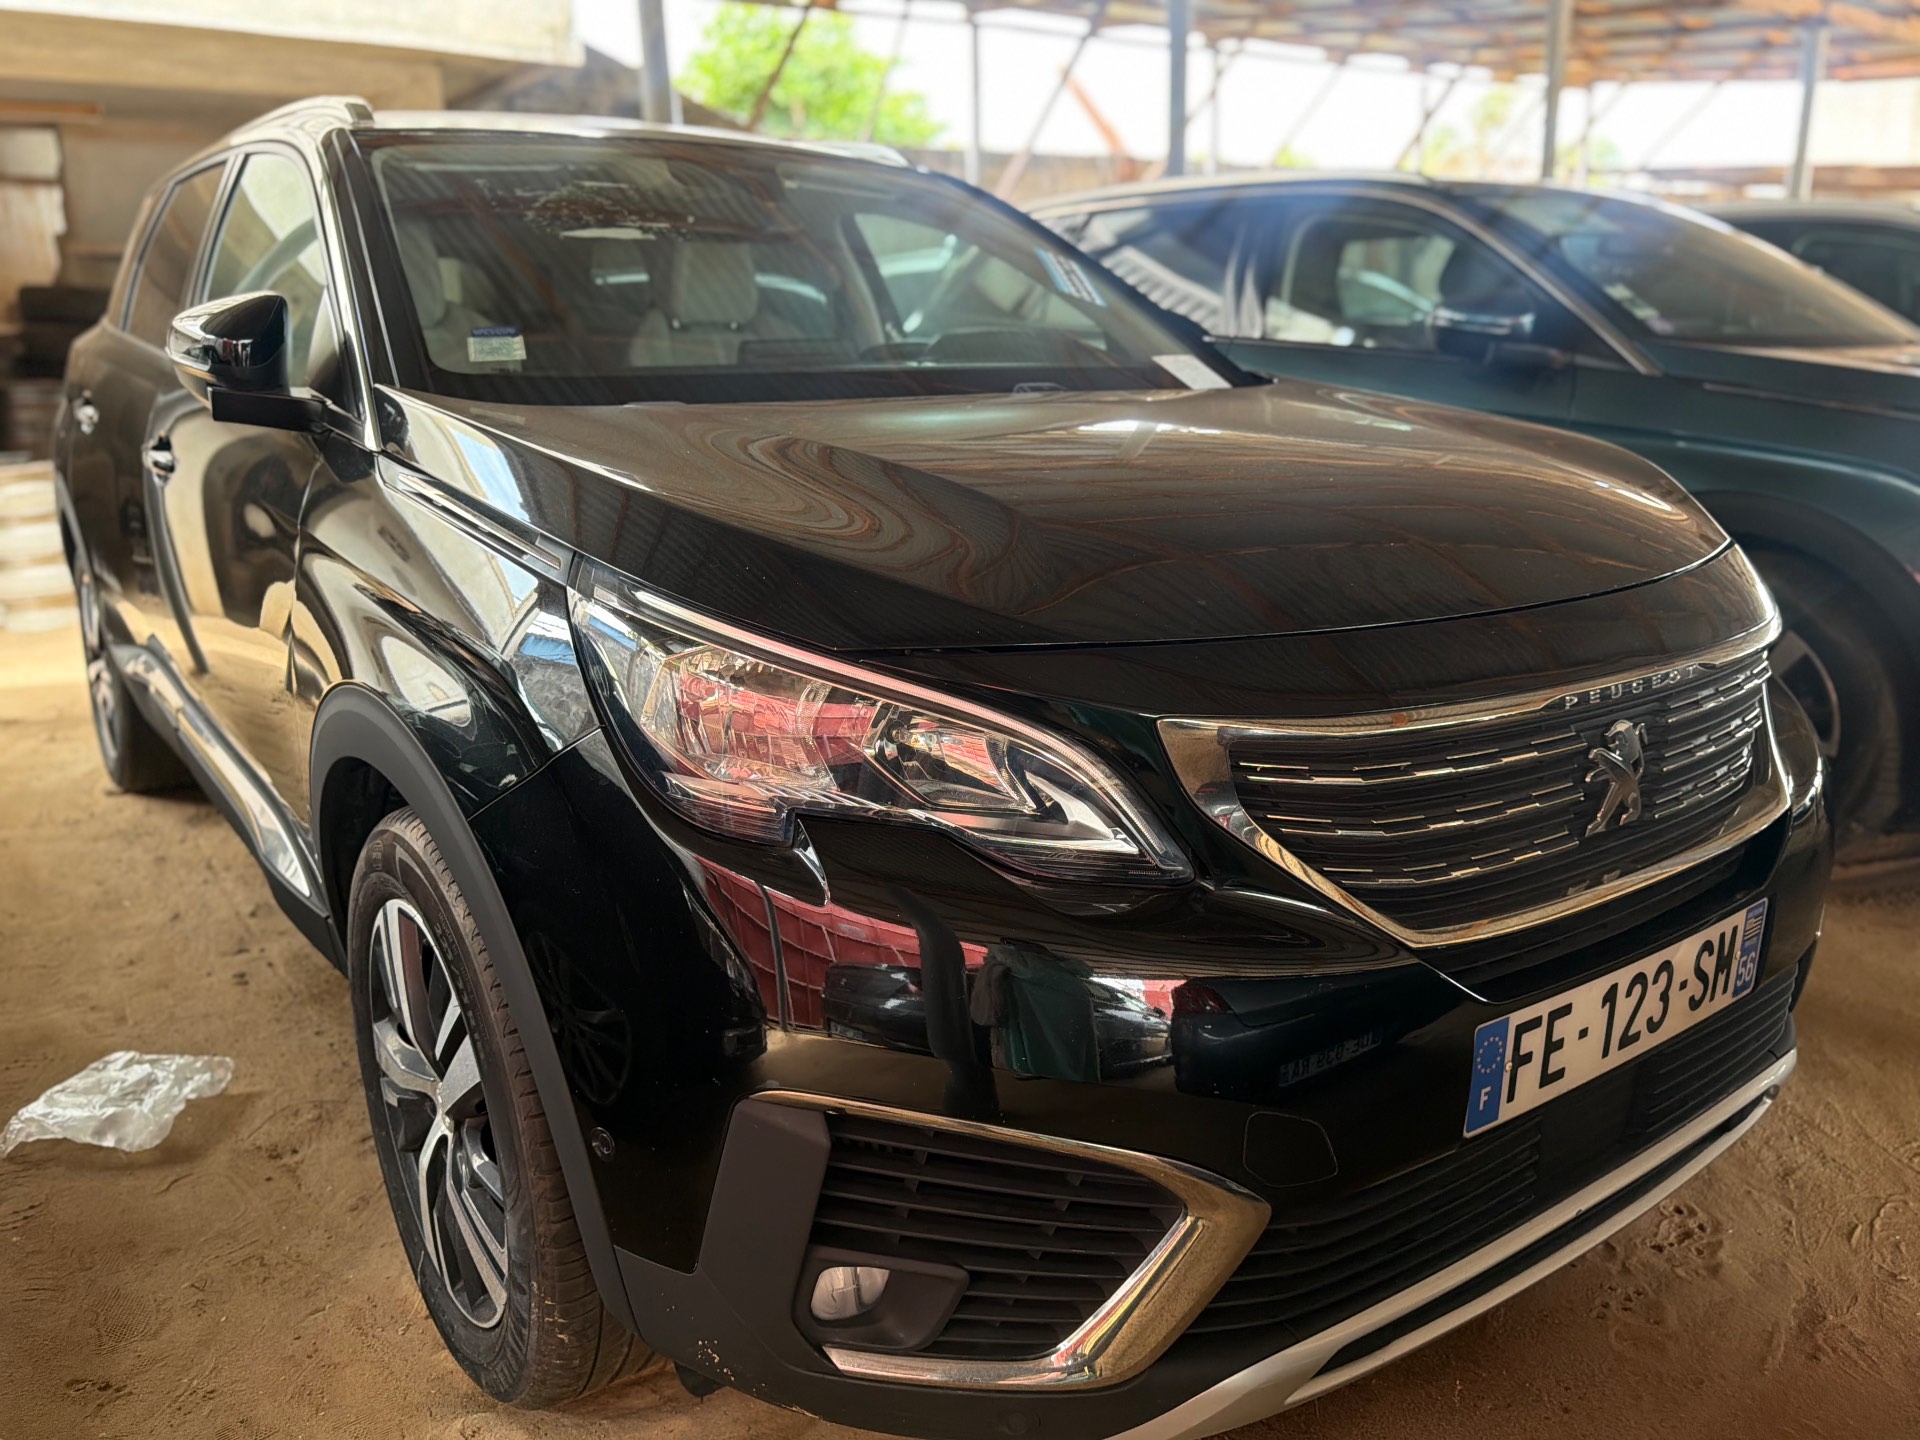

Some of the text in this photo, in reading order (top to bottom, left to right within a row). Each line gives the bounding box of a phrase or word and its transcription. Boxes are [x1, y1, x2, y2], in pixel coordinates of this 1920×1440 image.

[1565, 665, 1697, 710] PEUGEOT
[1737, 951, 1756, 987] 56
[1506, 925, 1739, 1104] FE-123-SM
[1479, 1086, 1492, 1112] F
